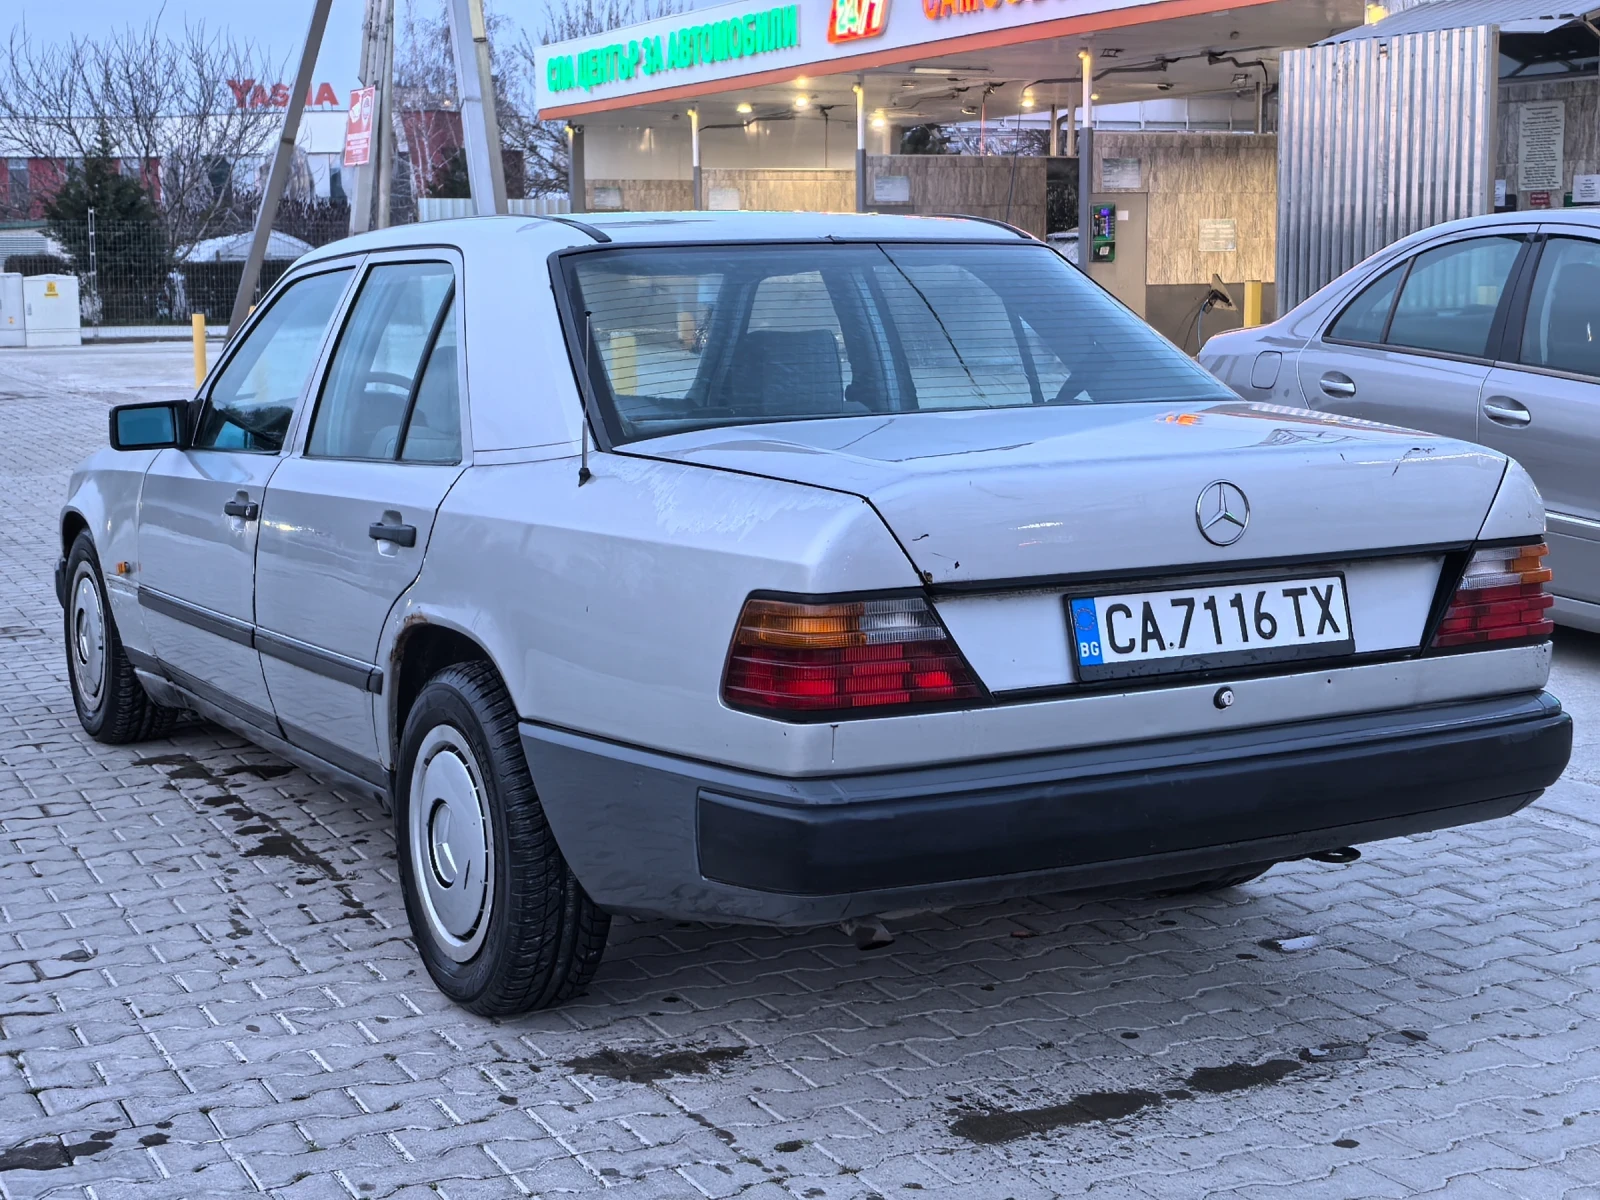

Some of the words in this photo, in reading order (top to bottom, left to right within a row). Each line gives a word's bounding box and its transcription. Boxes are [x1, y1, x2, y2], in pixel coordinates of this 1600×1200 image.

[577, 40, 639, 92] ЦЕНТЪР
[642, 35, 665, 76] ЗА
[667, 4, 798, 70] АВТОМОБИЛИ
[226, 79, 339, 108] YASA
[1080, 641, 1100, 658] BG
